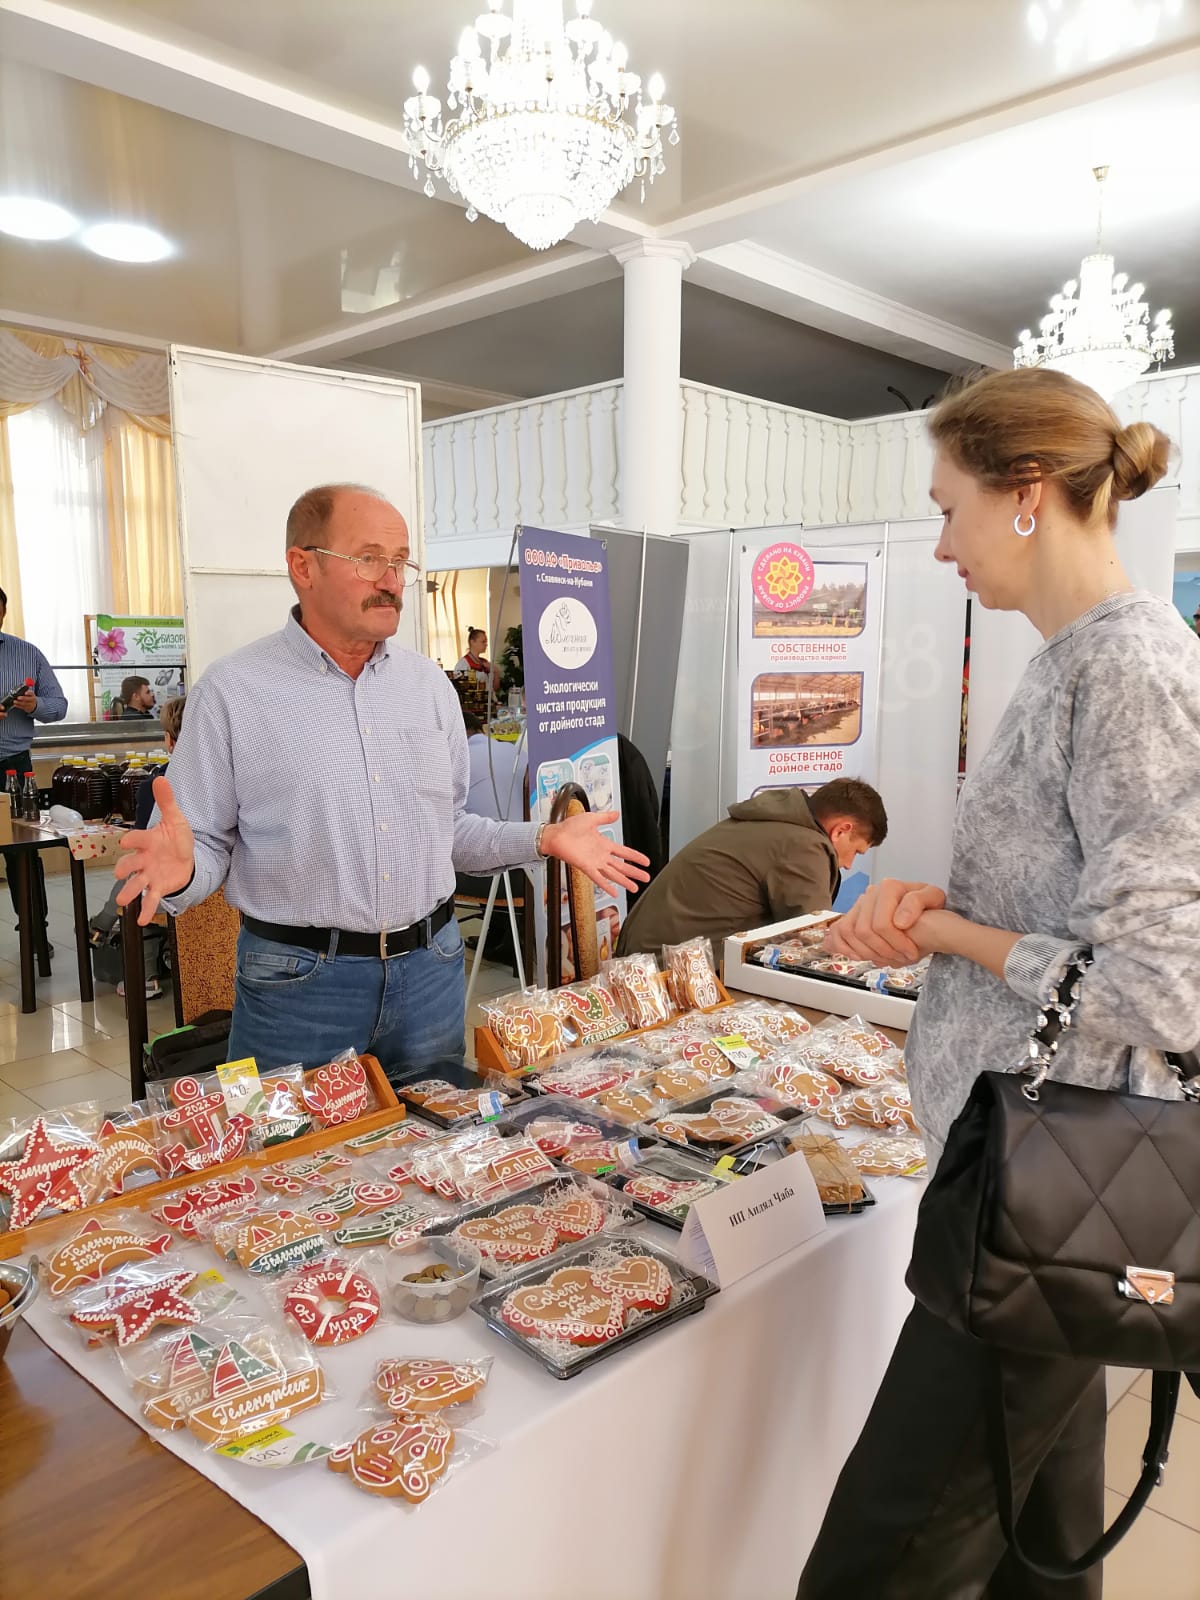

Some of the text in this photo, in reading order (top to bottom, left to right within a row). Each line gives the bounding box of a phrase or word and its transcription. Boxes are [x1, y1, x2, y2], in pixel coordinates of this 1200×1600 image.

[524, 548, 545, 566] ООО
[545, 552, 558, 568] АФ
[771, 643, 847, 653] СОБСТВЕННОЕ
[543, 681, 599, 695] Экологически
[536, 698, 607, 714] чистая продукция
[538, 715, 605, 733] от дойного стада
[769, 750, 843, 762] СОБСТВЕННОЕ
[769, 762, 843, 775] дойное стадо
[184, 1100, 211, 1118] 2022
[3, 1154, 82, 1182] Геленджик
[103, 1157, 126, 1182] 2022
[729, 1211, 746, 1227] ИП
[773, 1187, 795, 1202] Чаба
[467, 1223, 494, 1236] От
[60, 1234, 151, 1262] Геленджик
[73, 1250, 105, 1272] 2022
[523, 1281, 588, 1311] Совет
[212, 1377, 312, 1425] Геленджик
